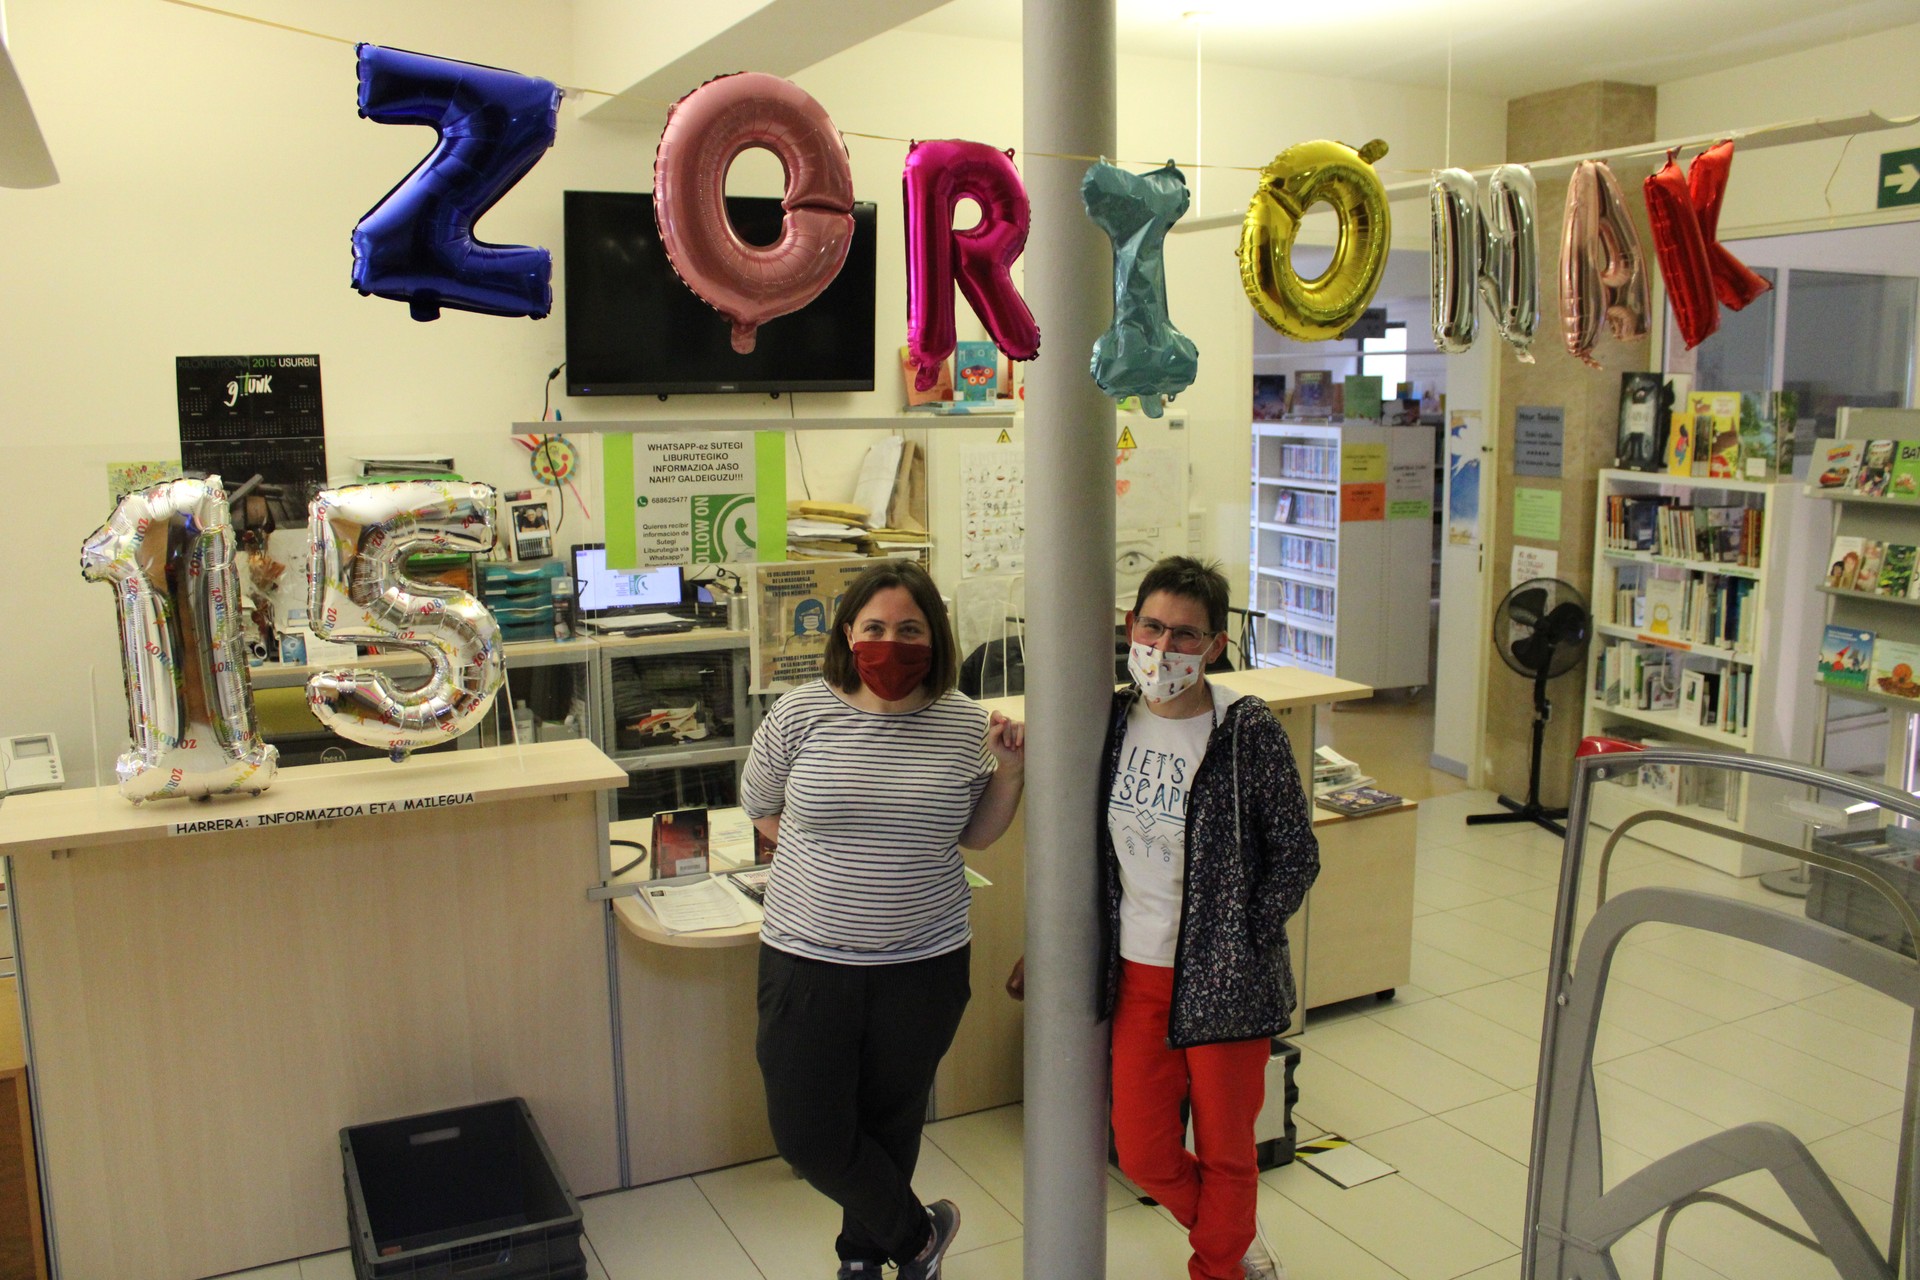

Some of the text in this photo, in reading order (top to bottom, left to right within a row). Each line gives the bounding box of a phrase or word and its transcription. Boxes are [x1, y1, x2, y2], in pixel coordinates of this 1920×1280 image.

[351, 43, 1773, 416] ZORIONAK
[252, 358, 277, 368] 2015
[278, 357, 318, 368] USURBIL
[647, 441, 743, 452] WHATSAPP-ez SUTEGI
[662, 452, 729, 462] LIBURUTEGIKO
[652, 462, 739, 473] INFORMAZIOA JASO
[649, 473, 744, 484] NAHI? GALDEIGUZU!!!
[651, 496, 688, 504] 688625477
[694, 496, 710, 516] ON
[642, 522, 689, 532] Quieres recibir
[656, 538, 677, 547] Sutegi
[643, 546, 678, 555] Liburutegia
[649, 554, 684, 562] Whatsapp?
[1127, 746, 1186, 784] LET'S
[176, 793, 475, 835] HARRERA: INFORMAZIOA ETA MAILEGUA
